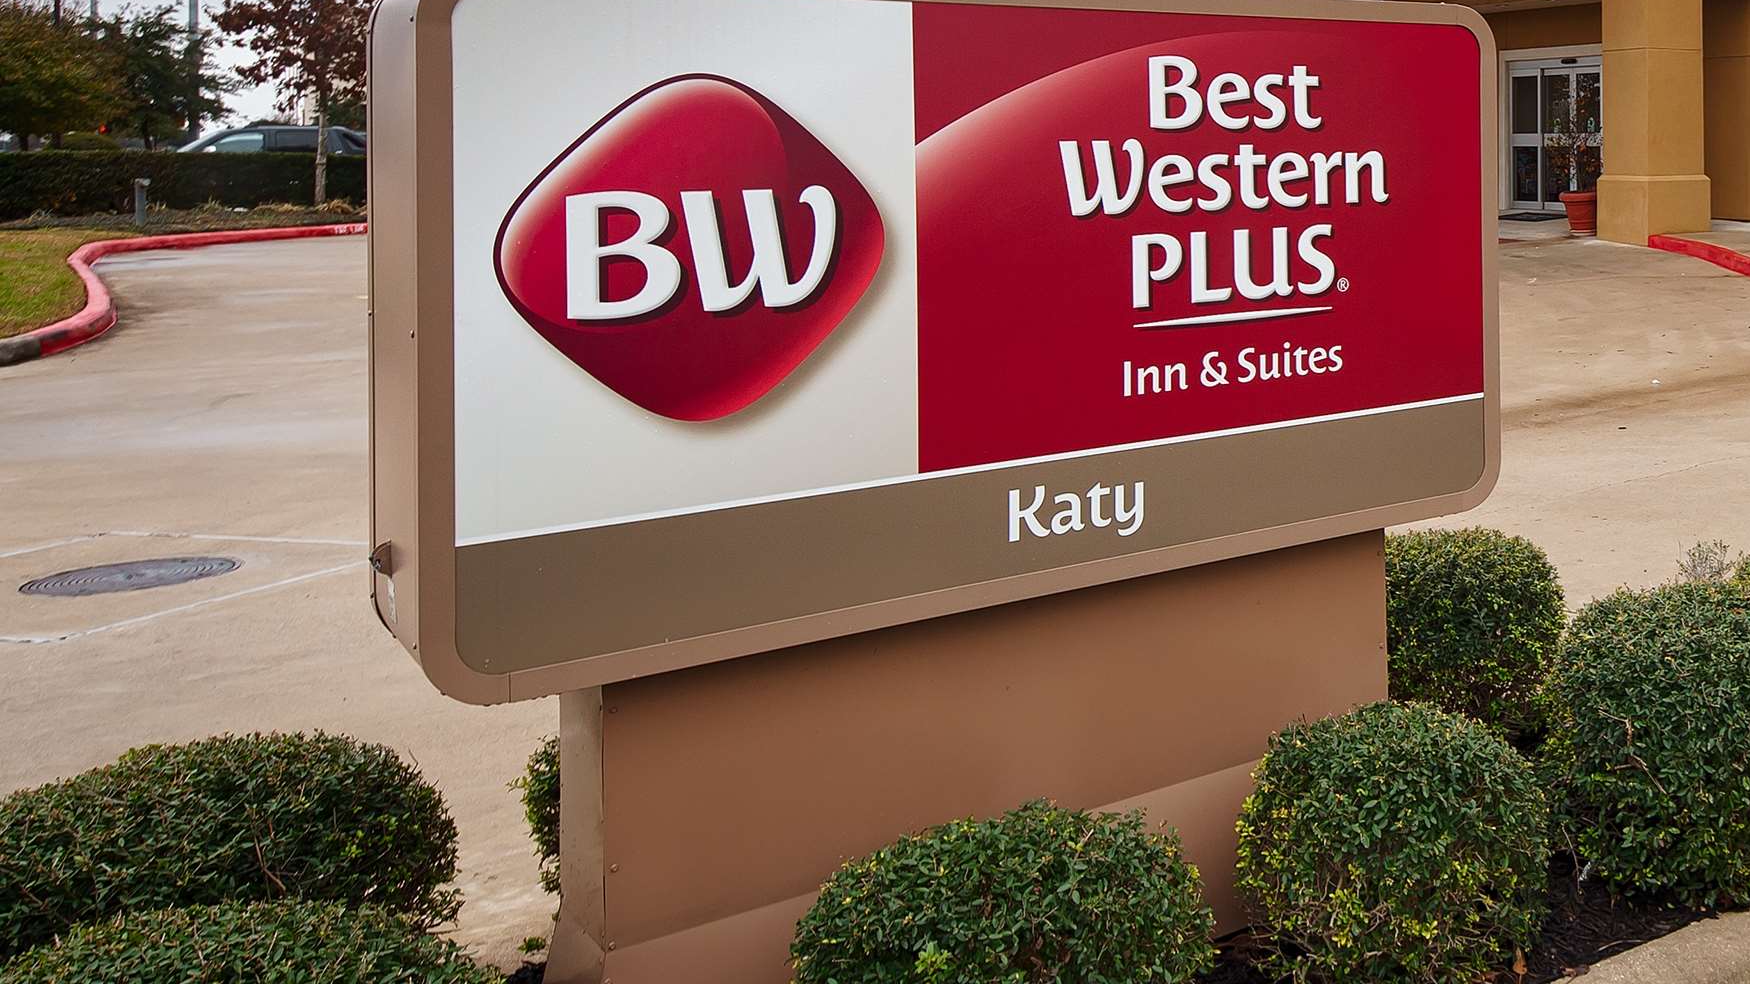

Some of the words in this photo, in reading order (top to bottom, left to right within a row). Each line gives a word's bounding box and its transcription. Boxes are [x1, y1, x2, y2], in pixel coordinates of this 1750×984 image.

[1148, 55, 1322, 130] Best
[1059, 138, 1390, 216] Western
[566, 185, 836, 320] BW
[1123, 361, 1189, 397] Inn
[1200, 351, 1230, 387] &
[1237, 341, 1344, 383] Suites
[1008, 480, 1145, 543] Katy
